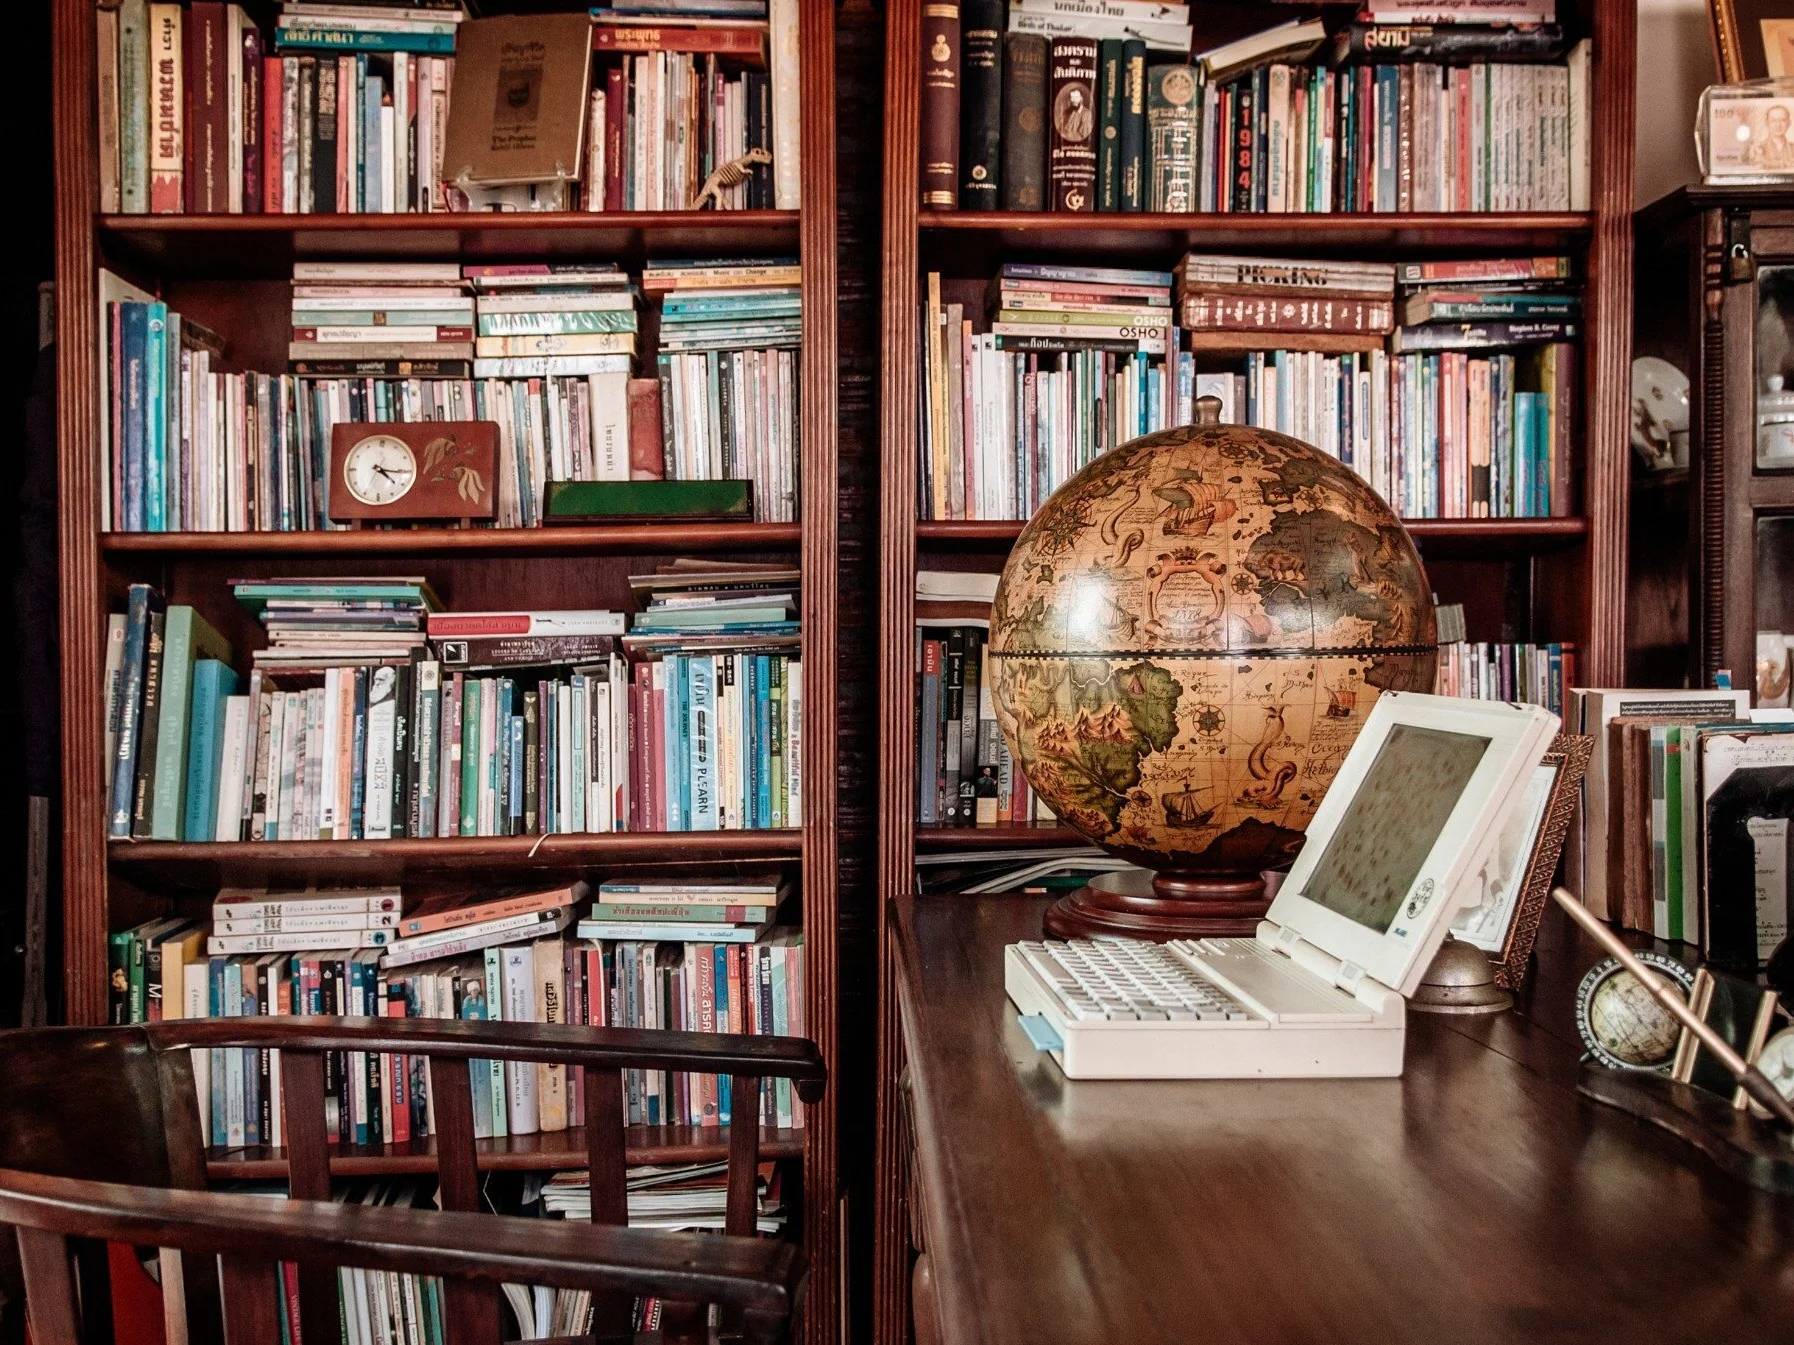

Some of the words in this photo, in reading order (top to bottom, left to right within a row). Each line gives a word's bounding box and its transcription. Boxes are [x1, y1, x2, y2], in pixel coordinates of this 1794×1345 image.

[162, 17, 176, 51] ตำรา
[1053, 45, 1097, 58] สงคราม
[158, 57, 183, 158] พรหมชาติ
[1238, 108, 1252, 190] 1984
[1119, 327, 1159, 339] OSHO
[1133, 314, 1168, 327] OSHO
[791, 739, 801, 776] Beautiful
[697, 768, 708, 814] PLEARN
[791, 777, 800, 796] Mind
